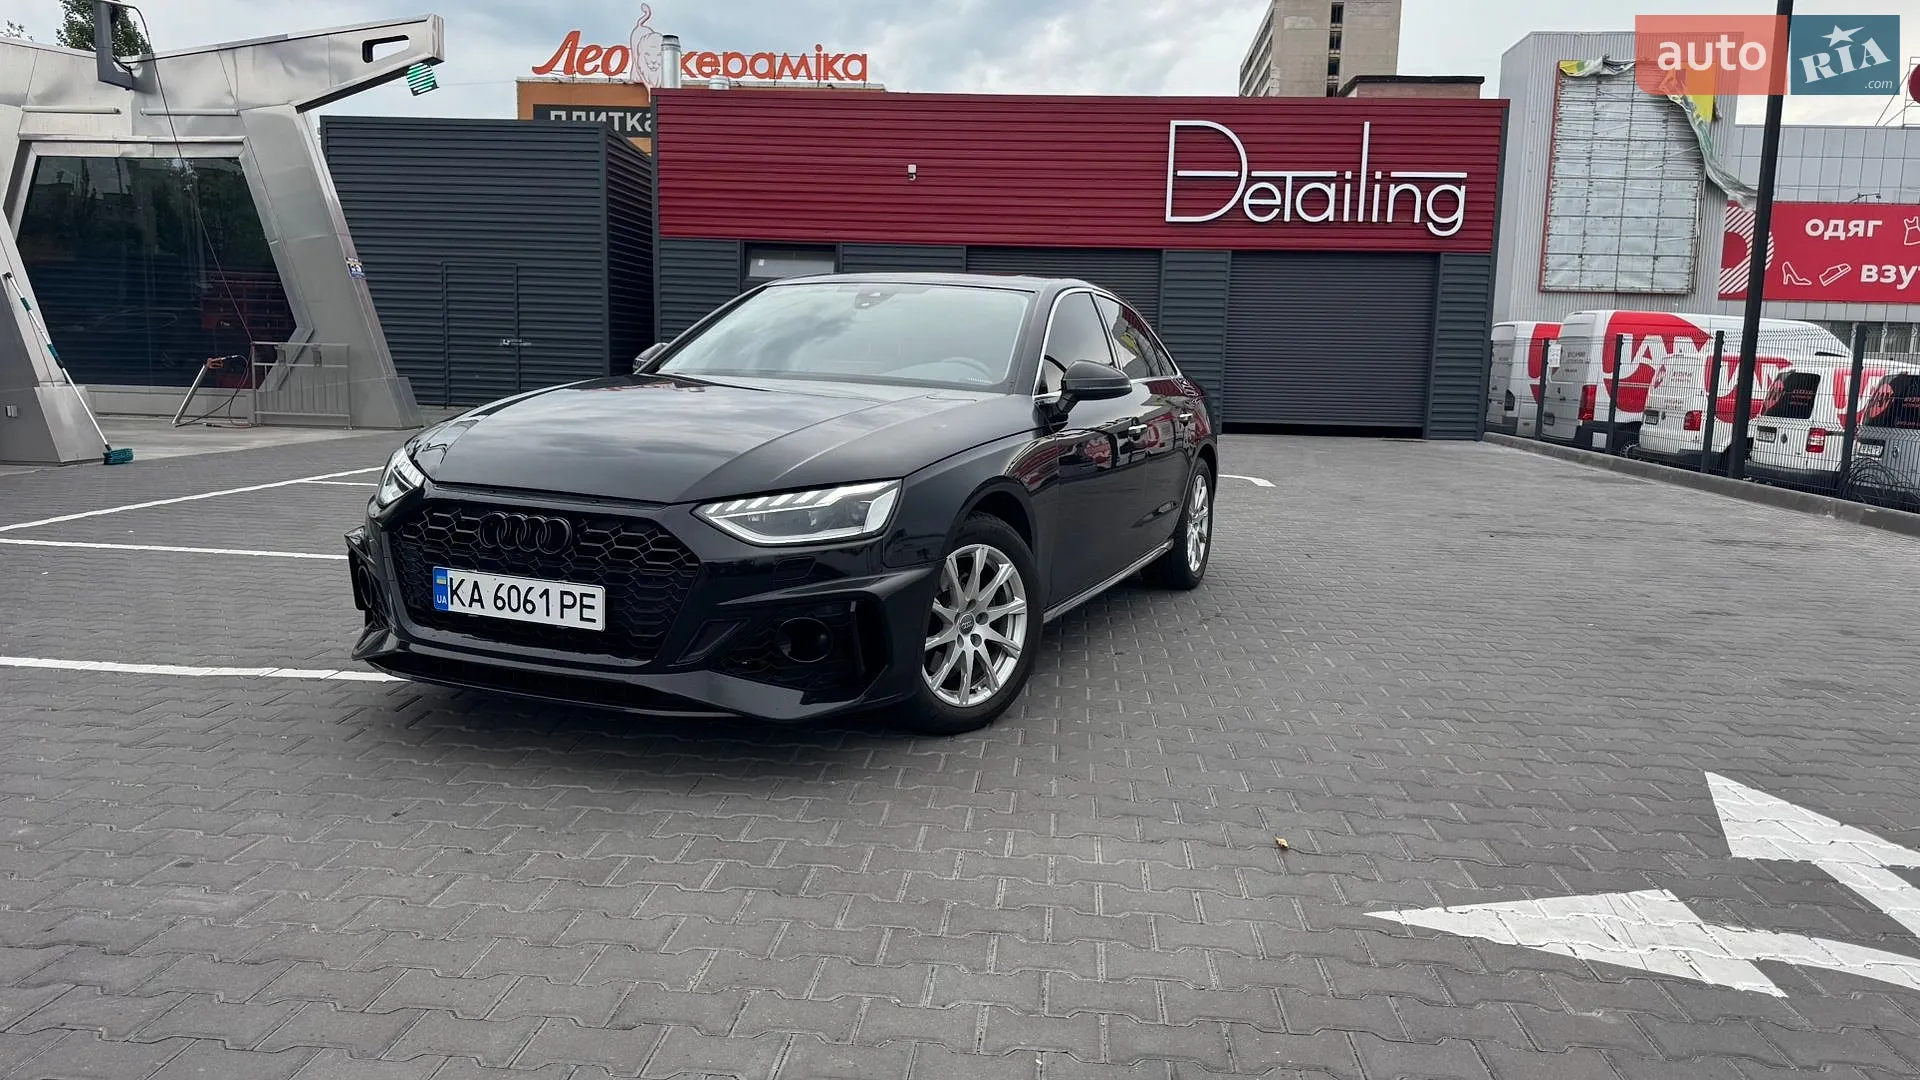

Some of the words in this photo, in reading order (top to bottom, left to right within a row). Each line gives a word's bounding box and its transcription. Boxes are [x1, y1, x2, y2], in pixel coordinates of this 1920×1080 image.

[532, 30, 630, 76] Лео
[680, 44, 868, 81] кераміка
[1860, 264, 1920, 290] взу
[436, 593, 447, 605] UA
[449, 577, 485, 610] KA
[493, 582, 551, 618] 6061
[559, 590, 597, 624] PE
